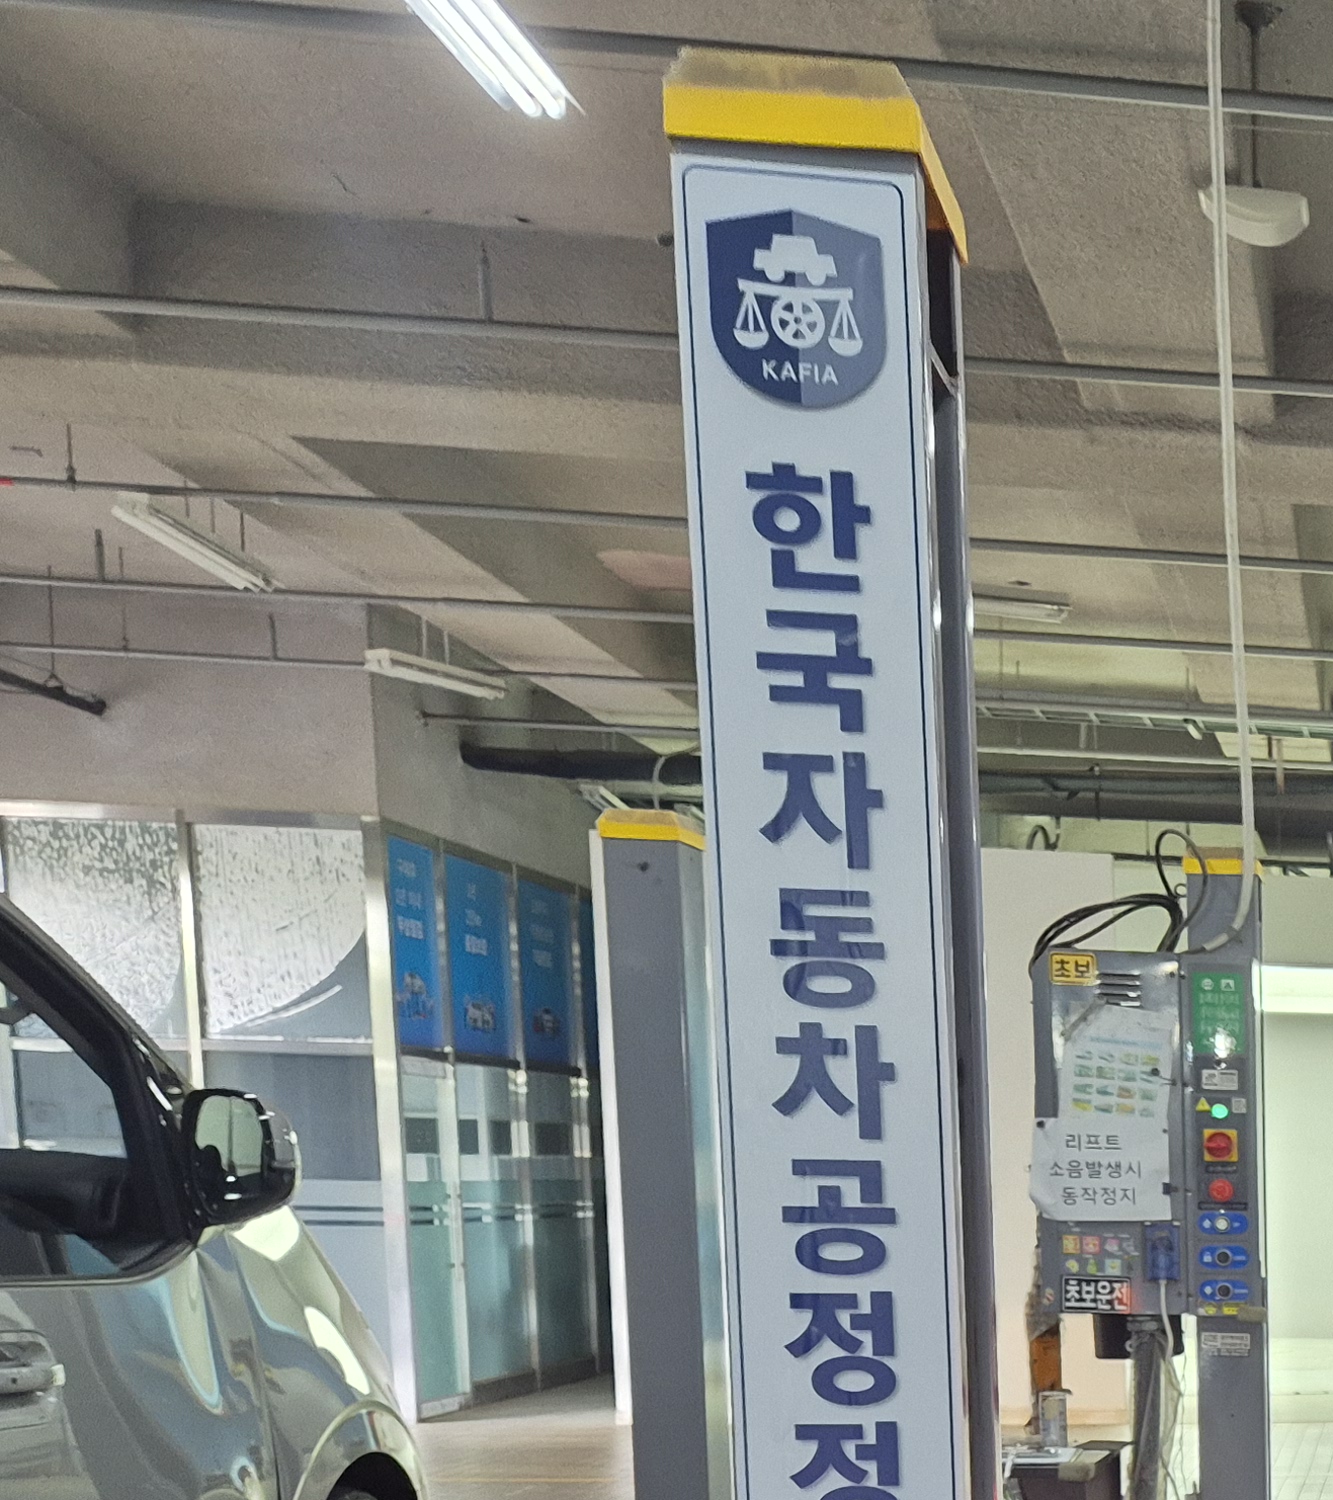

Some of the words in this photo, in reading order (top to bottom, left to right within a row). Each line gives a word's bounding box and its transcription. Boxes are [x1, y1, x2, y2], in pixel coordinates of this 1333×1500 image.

[762, 358, 839, 385] KAFIA
[1054, 959, 1092, 978] 초보
[1065, 1133, 1122, 1151] 리프트
[1049, 1159, 1142, 1179] 소음발생시
[1061, 1186, 1136, 1206] 동작정지
[1065, 1279, 1131, 1311] 초보운전
